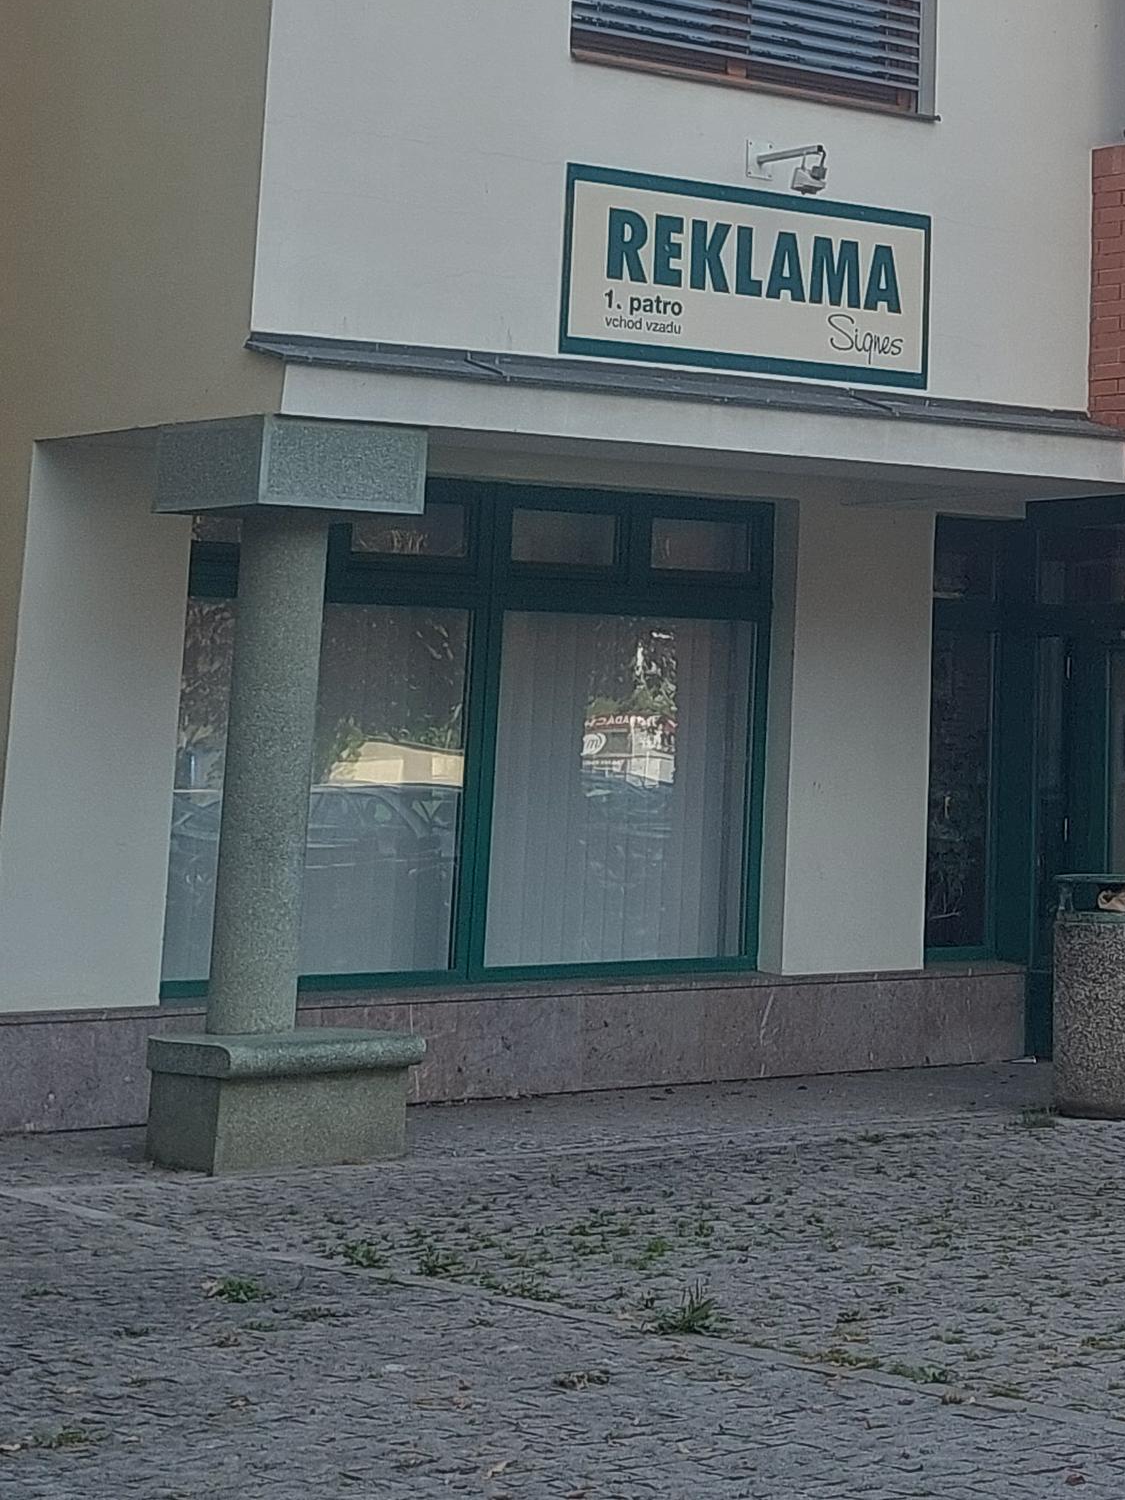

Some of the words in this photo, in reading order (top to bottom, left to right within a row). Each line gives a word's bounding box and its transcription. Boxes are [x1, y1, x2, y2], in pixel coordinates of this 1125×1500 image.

[605, 206, 903, 314] REKLAMA
[604, 289, 622, 310] 1.
[629, 295, 683, 316] patro
[604, 315, 643, 330] vchod
[645, 321, 682, 334] vzadu
